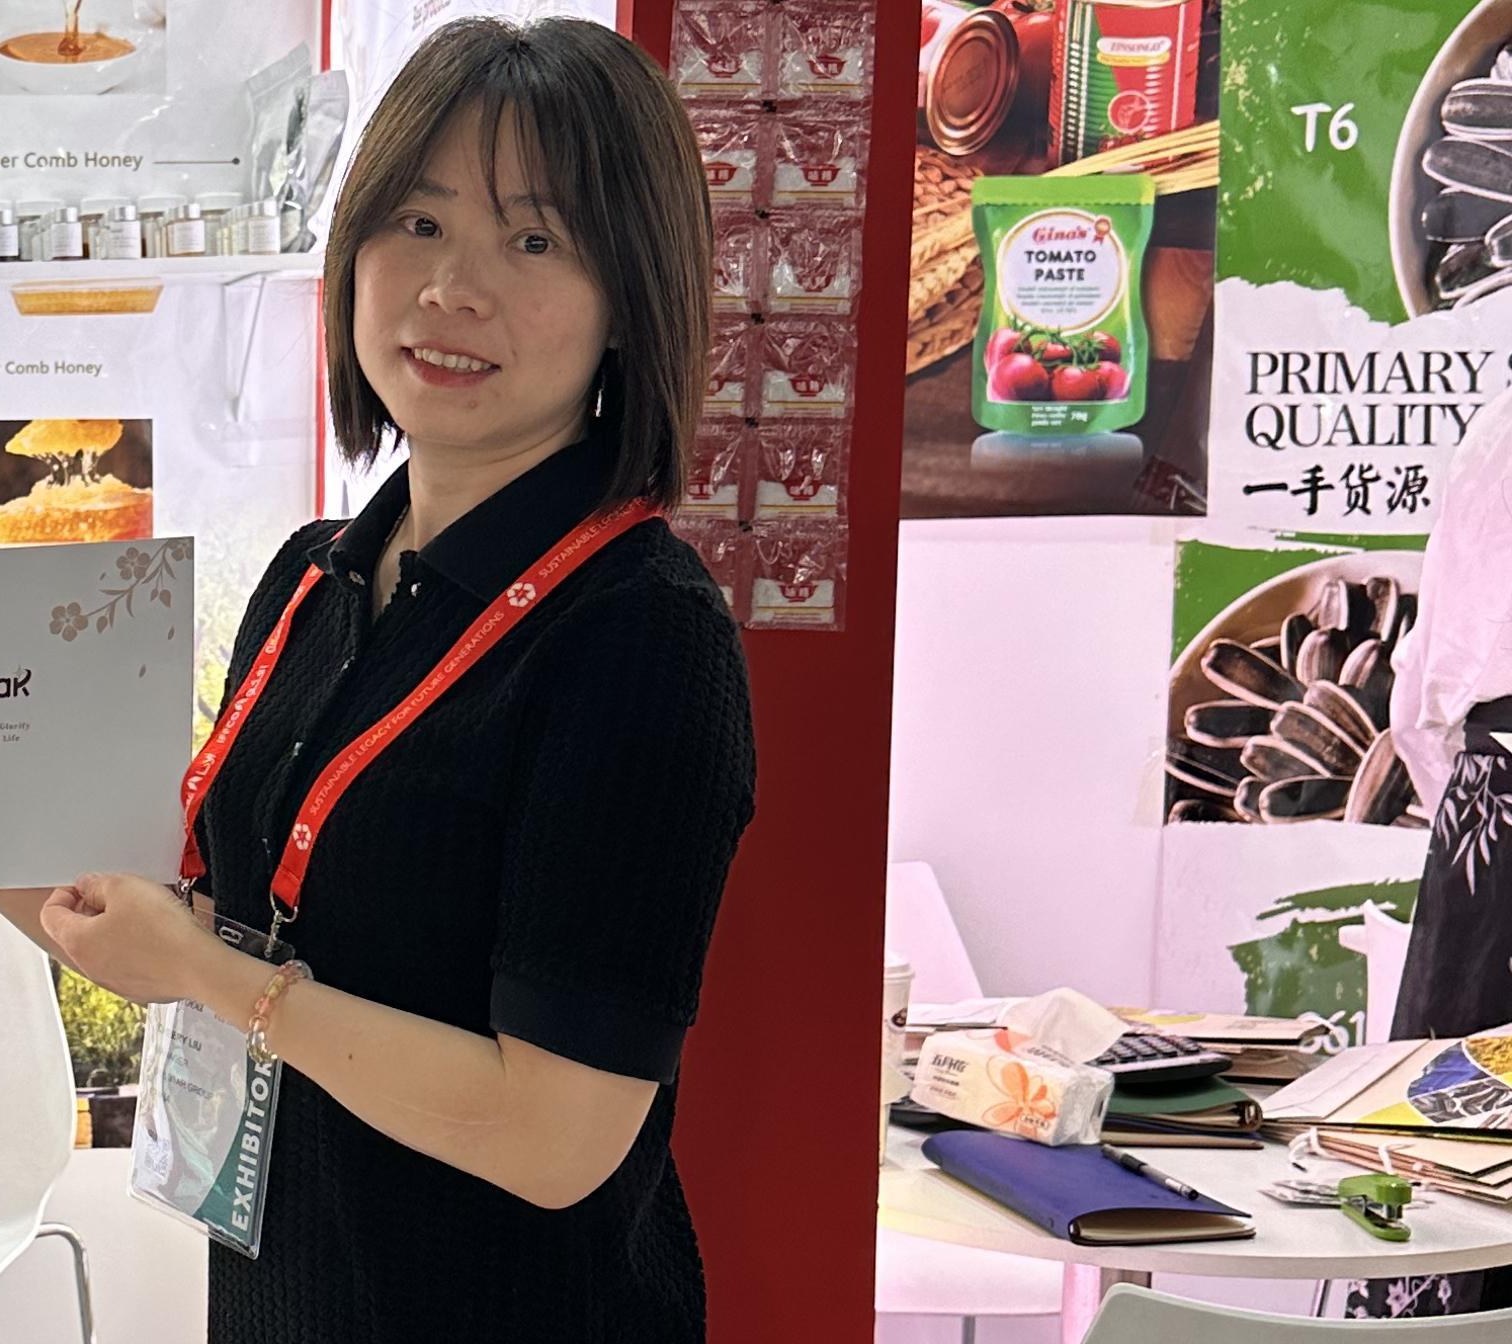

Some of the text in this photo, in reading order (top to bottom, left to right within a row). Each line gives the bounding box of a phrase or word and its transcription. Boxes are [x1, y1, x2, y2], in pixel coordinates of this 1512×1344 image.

[1291, 102, 1360, 152] T6
[23, 151, 79, 169] Comb
[83, 151, 144, 172] Honey
[1024, 250, 1097, 264] TOMATO
[1034, 267, 1086, 282] PASTE
[4, 360, 50, 376] Comb
[53, 360, 103, 378] Honey
[1246, 350, 1496, 396] PRIMARY
[1245, 402, 1484, 450] QUALITY
[1242, 463, 1433, 519] 一手货源
